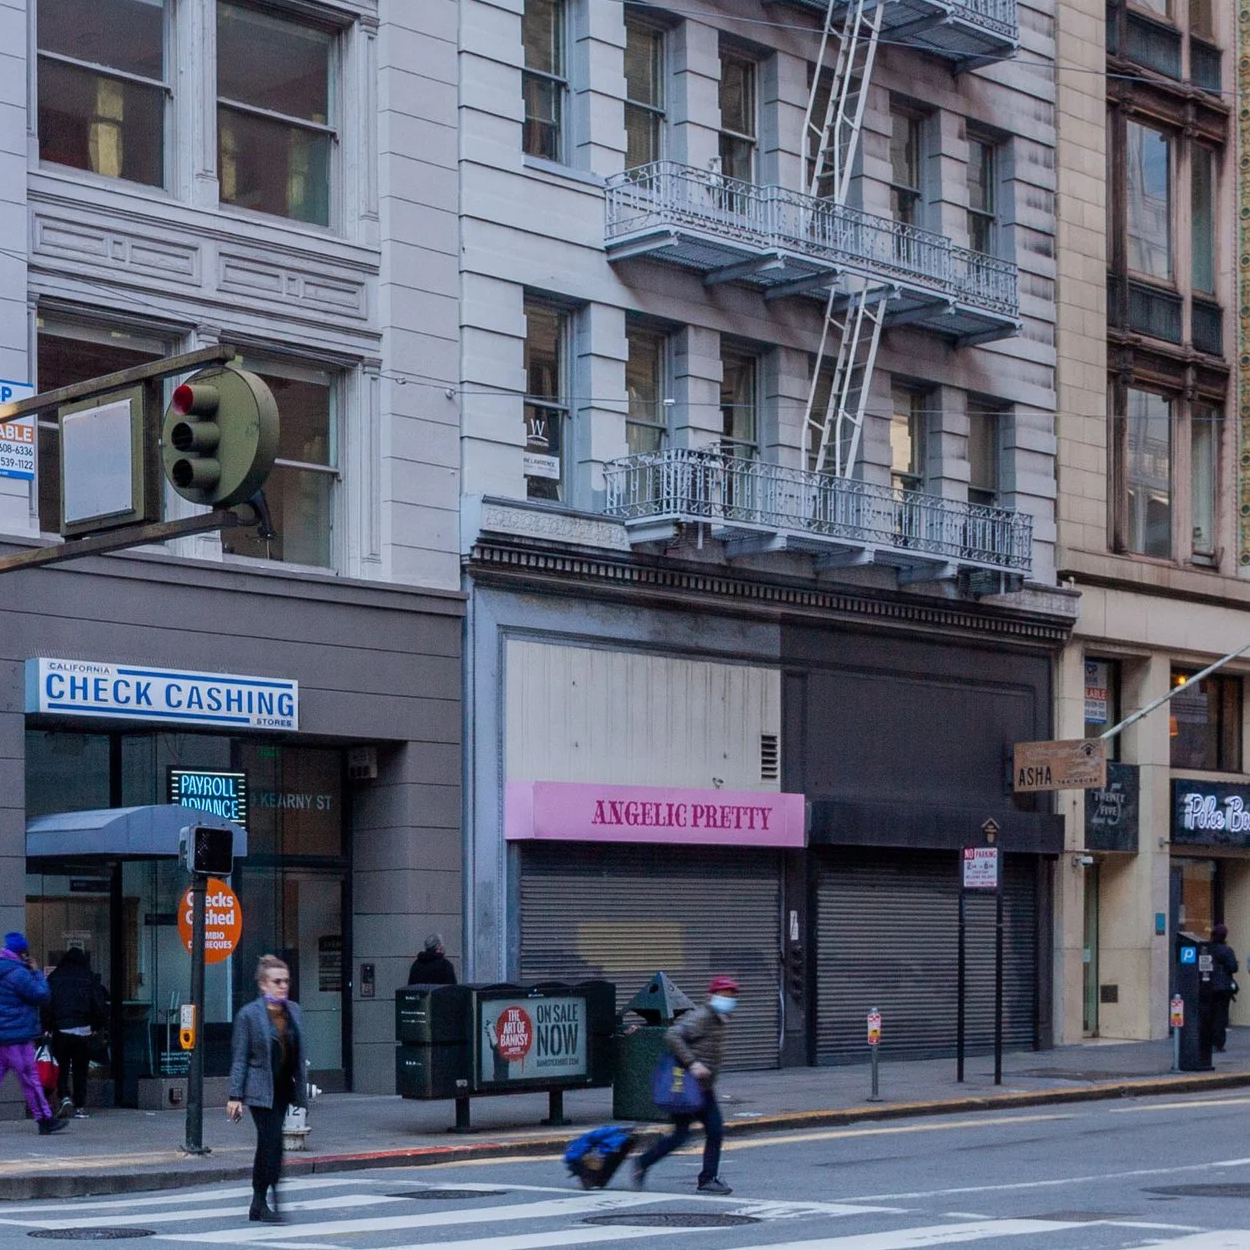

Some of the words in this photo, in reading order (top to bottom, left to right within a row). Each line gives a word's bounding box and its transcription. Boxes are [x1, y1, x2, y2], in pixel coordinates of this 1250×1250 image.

[530, 418, 545, 436] W
[49, 662, 111, 674] CALIFORNIA
[45, 674, 152, 707] CHECK
[165, 683, 295, 717] CASHING
[256, 717, 292, 727] STORES
[1018, 766, 1052, 786] ASHA
[181, 775, 237, 798] PAYROLL
[181, 797, 239, 819] ADVANCE
[261, 792, 313, 809] KEARNY
[316, 794, 332, 810] ST
[591, 800, 687, 828] ANGELIC
[692, 804, 772, 831] PRETTY
[1187, 793, 1226, 830] Poke
[964, 848, 974, 859] NO
[187, 891, 233, 907] Cecks
[185, 909, 235, 925] Cshed
[508, 1009, 520, 1022] THE
[537, 1005, 553, 1024] ON
[553, 1003, 578, 1023] SALE
[503, 1023, 517, 1034] ART
[517, 1021, 525, 1033] OF
[500, 1033, 529, 1047] BANKSY
[537, 1023, 578, 1057] NOW
